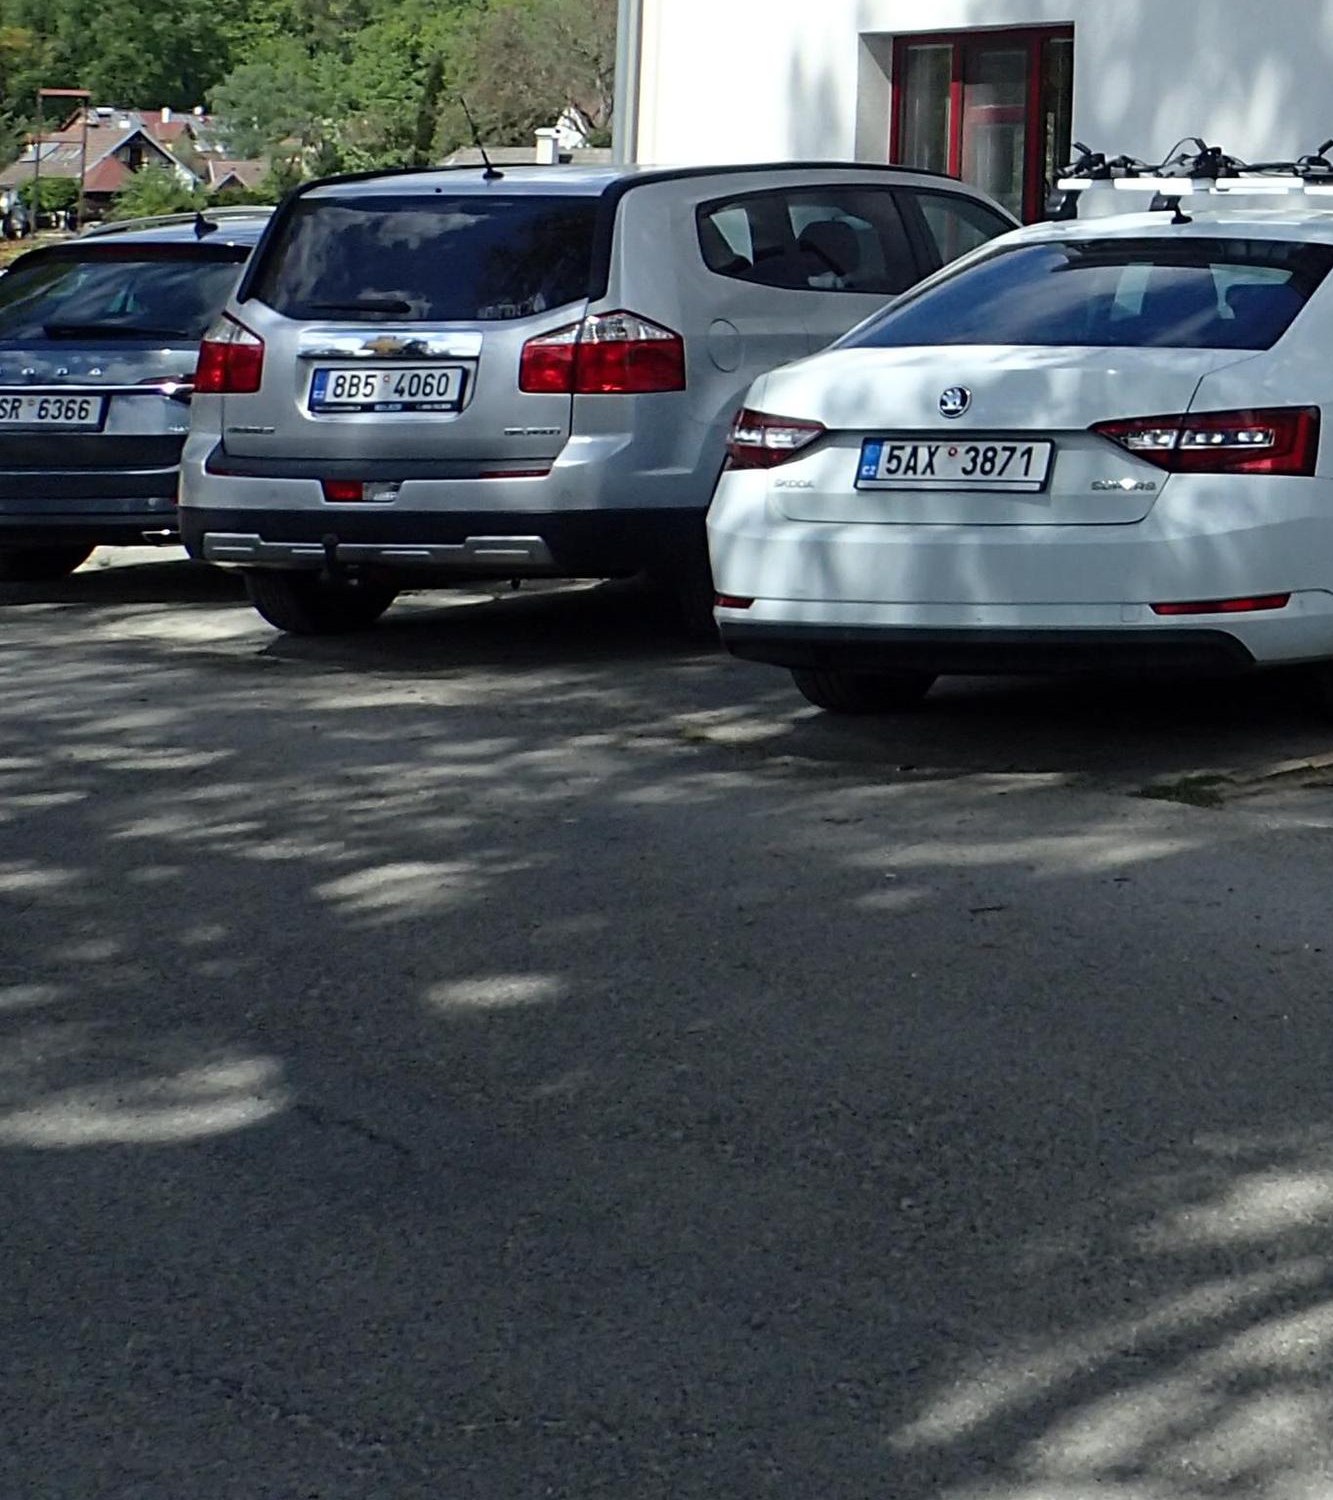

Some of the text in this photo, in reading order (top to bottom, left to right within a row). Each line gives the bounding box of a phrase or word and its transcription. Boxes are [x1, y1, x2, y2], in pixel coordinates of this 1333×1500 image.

[333, 373, 449, 398] 8B5 4060
[37, 398, 91, 420] 6366
[886, 445, 1034, 477] 5AX 3871
